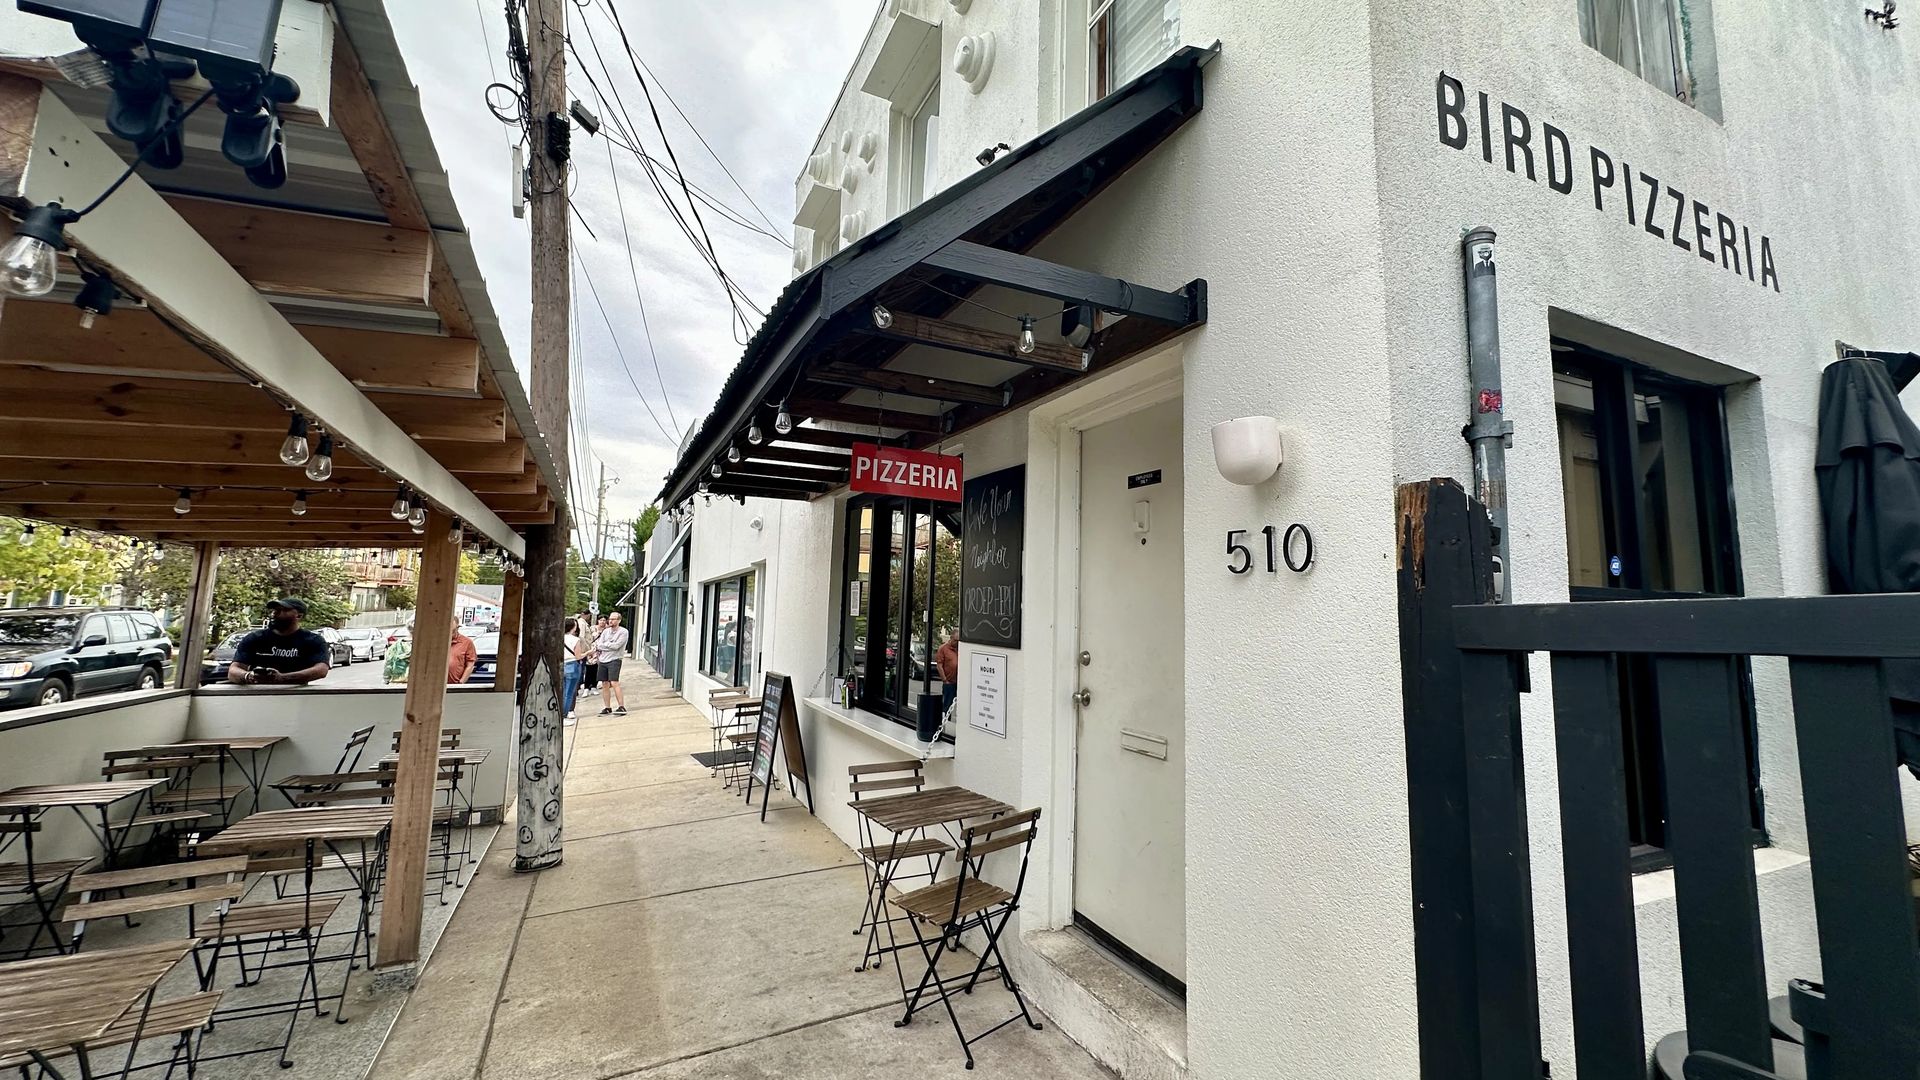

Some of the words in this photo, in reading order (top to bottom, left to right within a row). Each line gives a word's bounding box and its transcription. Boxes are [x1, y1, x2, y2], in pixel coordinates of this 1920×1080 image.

[1437, 70, 1573, 195] BIRD
[1590, 146, 1780, 293] PIZZERIA
[856, 456, 958, 491] PIZZERIA
[1227, 523, 1313, 574] 510
